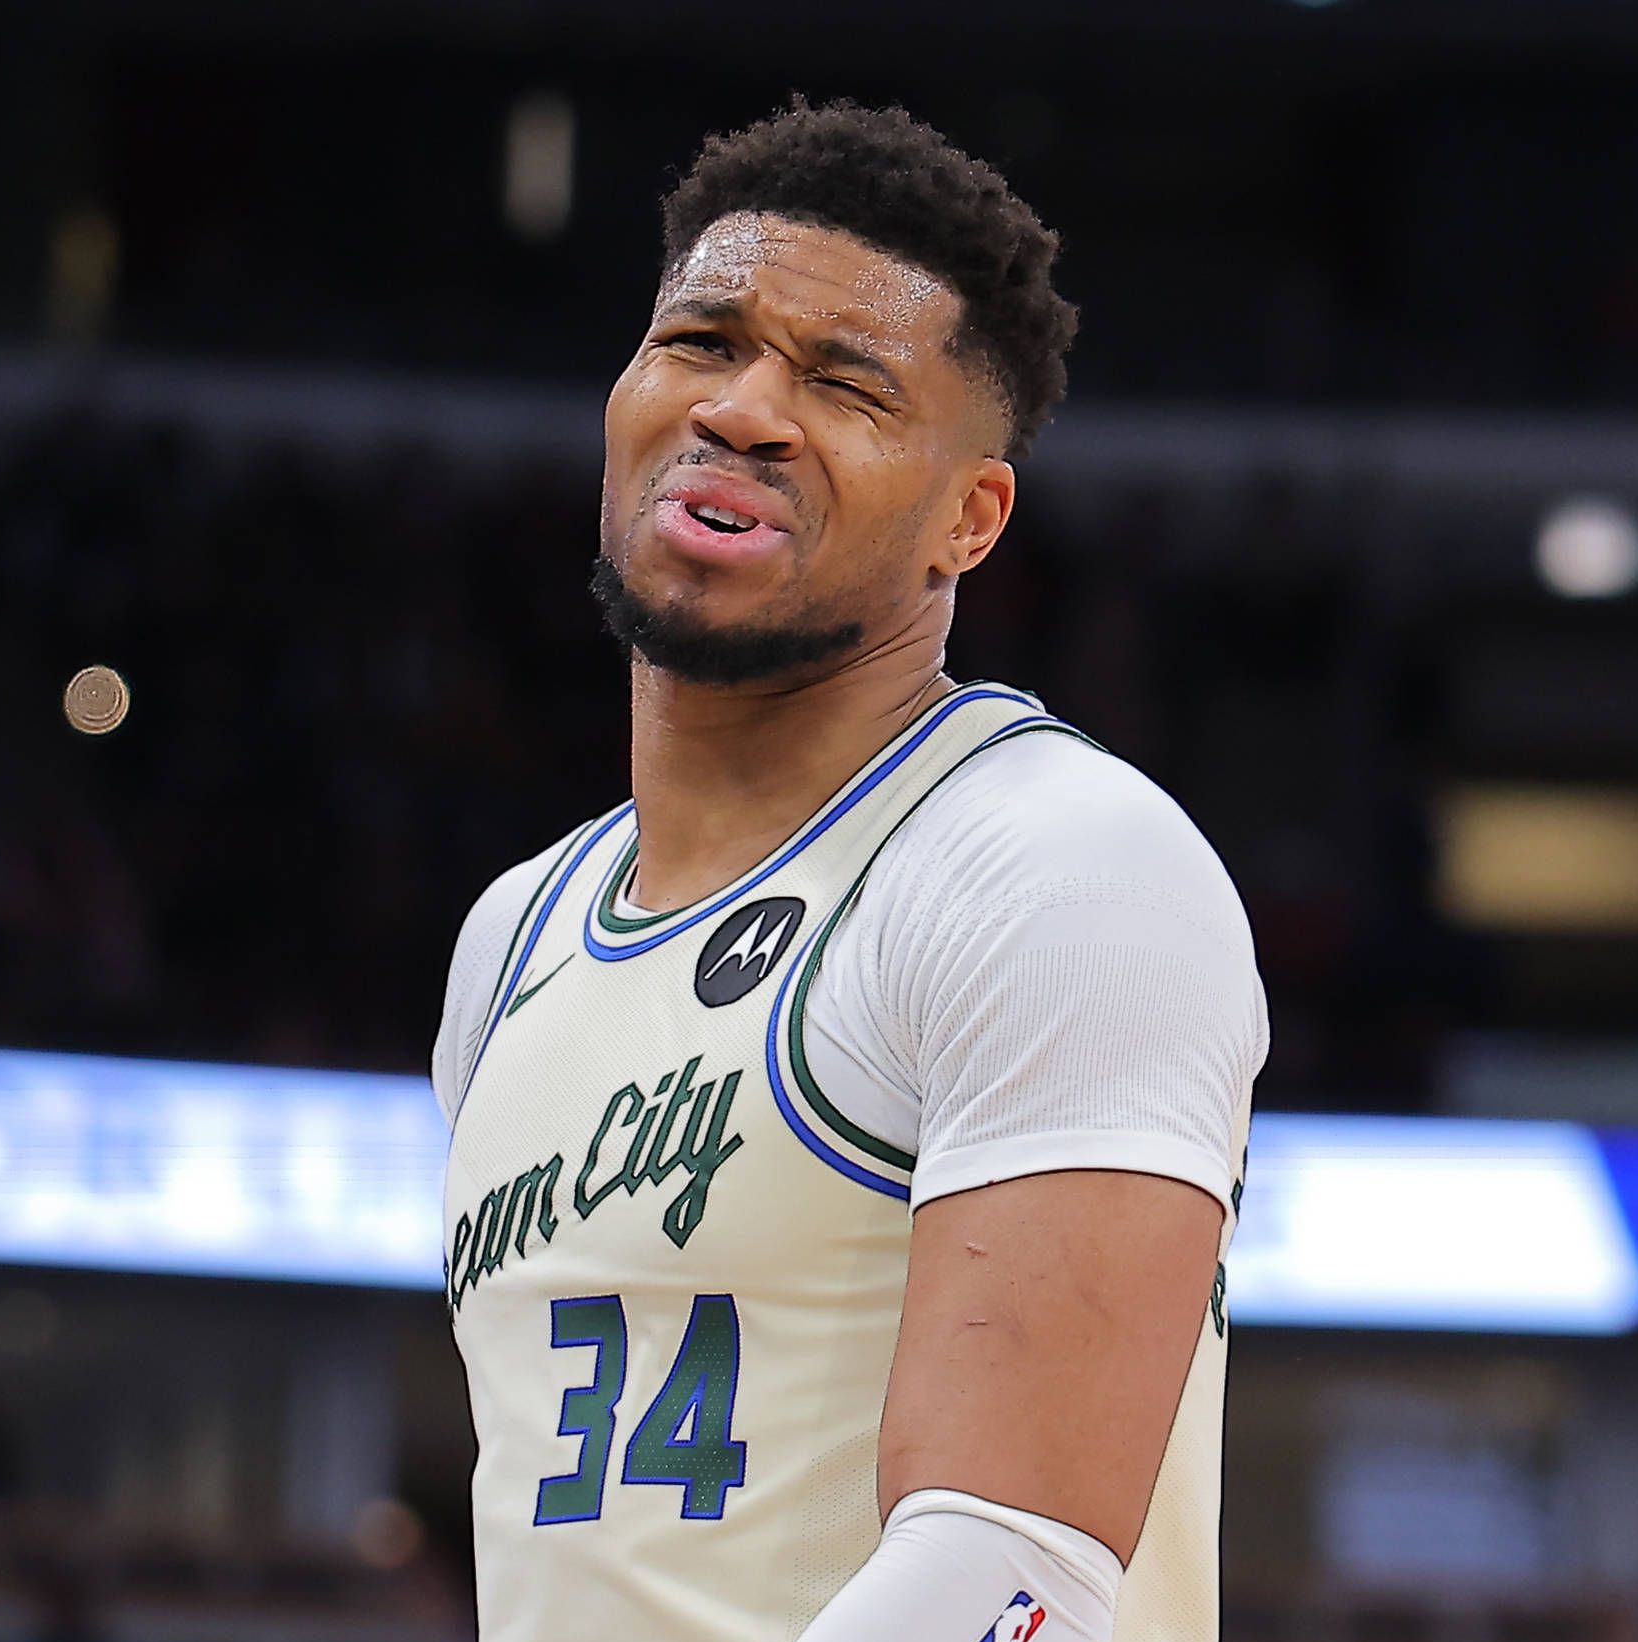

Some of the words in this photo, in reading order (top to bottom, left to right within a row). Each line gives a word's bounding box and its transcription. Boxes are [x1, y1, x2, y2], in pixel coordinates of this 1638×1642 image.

[445, 1154, 563, 1313] eam
[573, 1055, 744, 1249] City
[533, 1294, 748, 1526] 34
